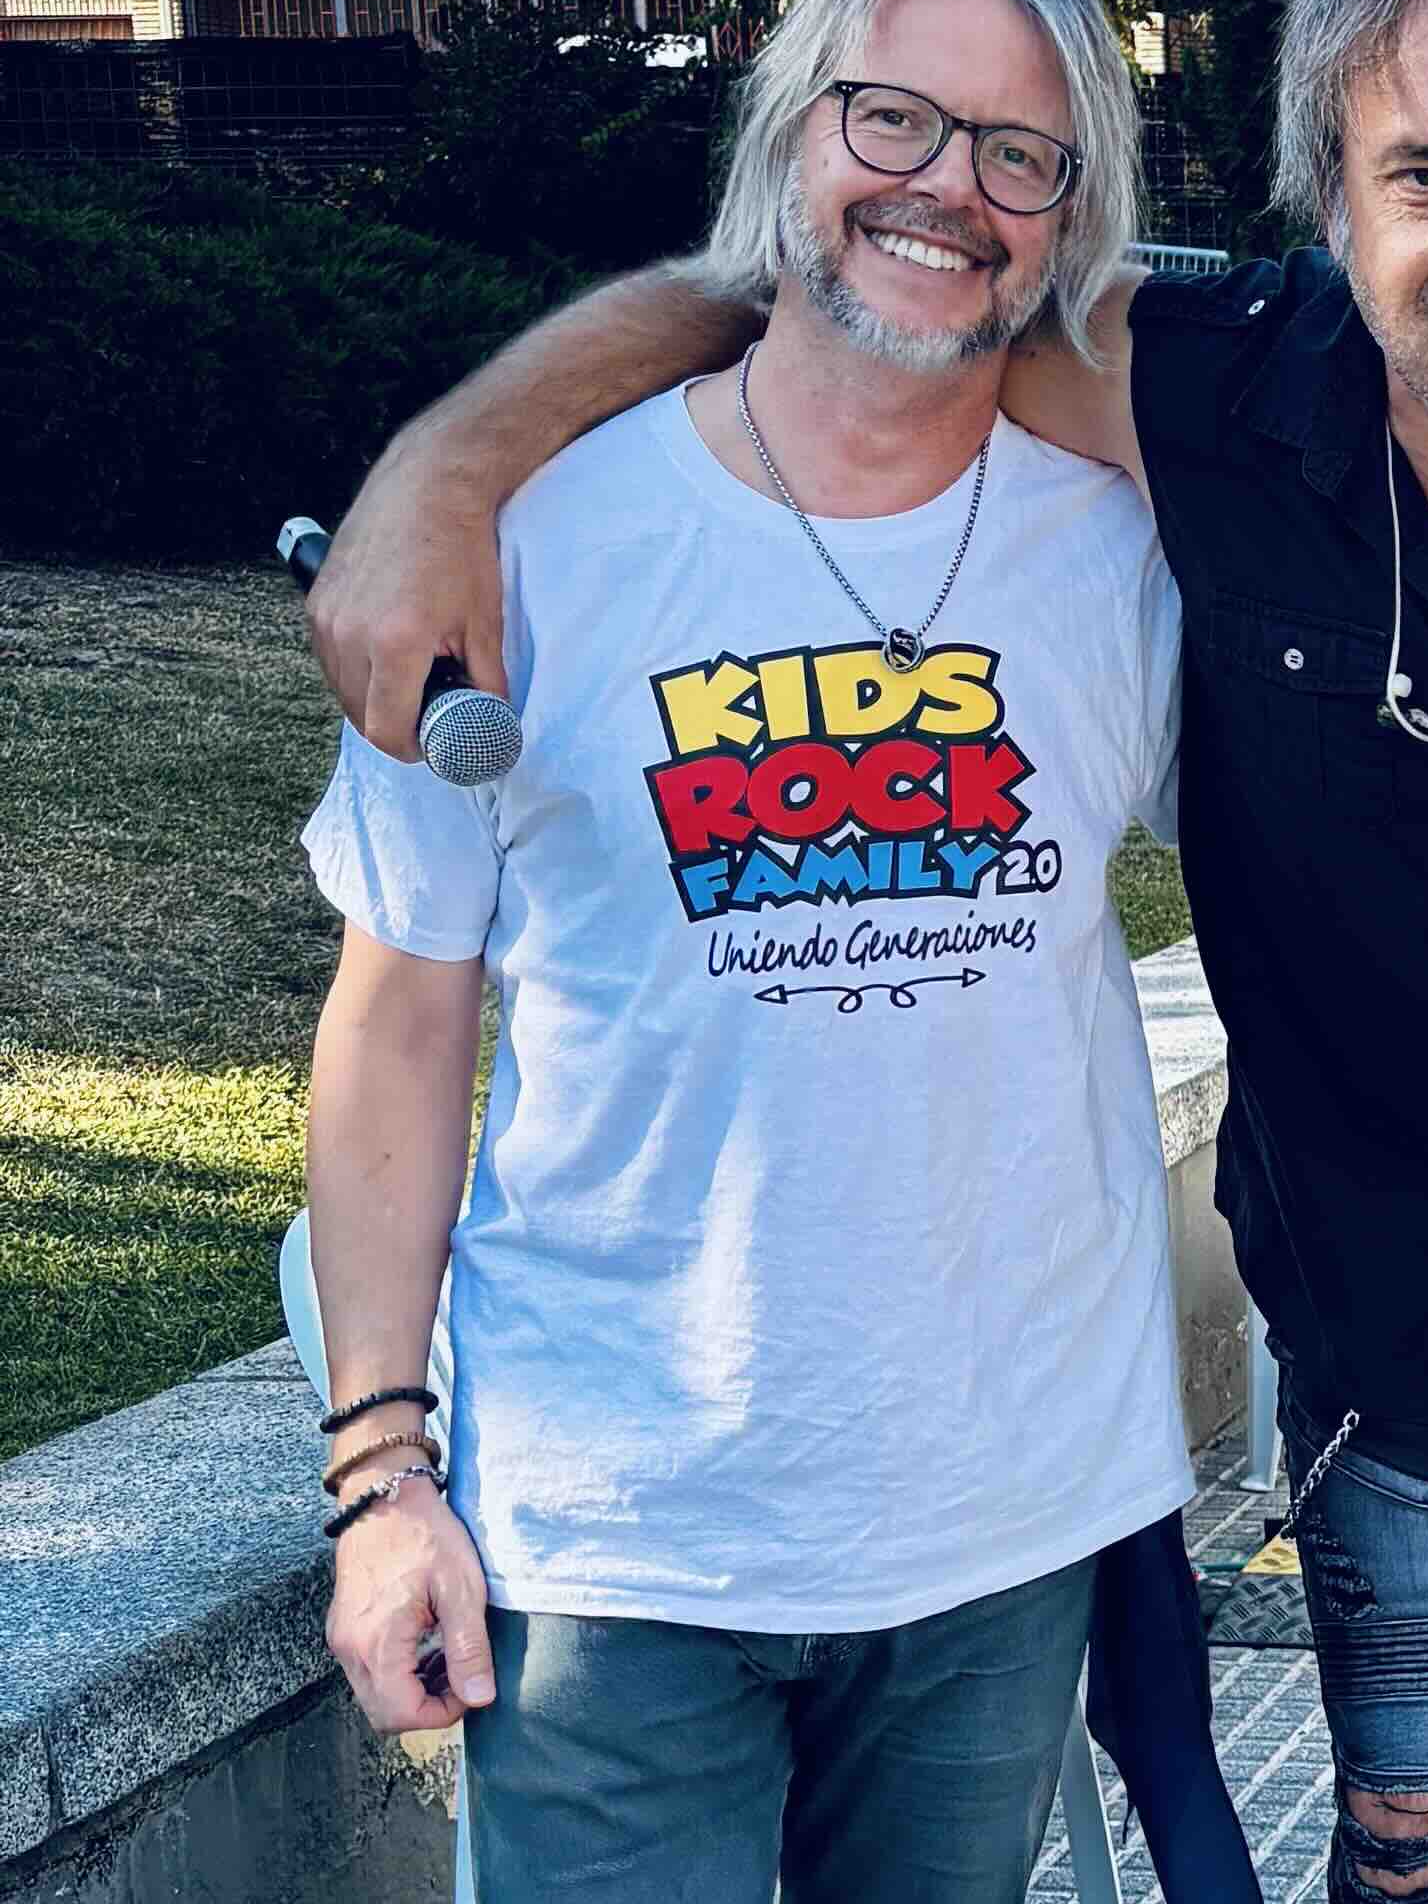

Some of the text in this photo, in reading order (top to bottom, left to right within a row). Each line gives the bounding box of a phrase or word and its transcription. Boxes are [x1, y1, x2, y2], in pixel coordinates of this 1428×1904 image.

[650, 642, 1004, 756] KIDS
[643, 733, 1036, 855] ROCK
[669, 836, 1002, 922] FAMILY
[708, 911, 1037, 977] Uniendo Generaciones
